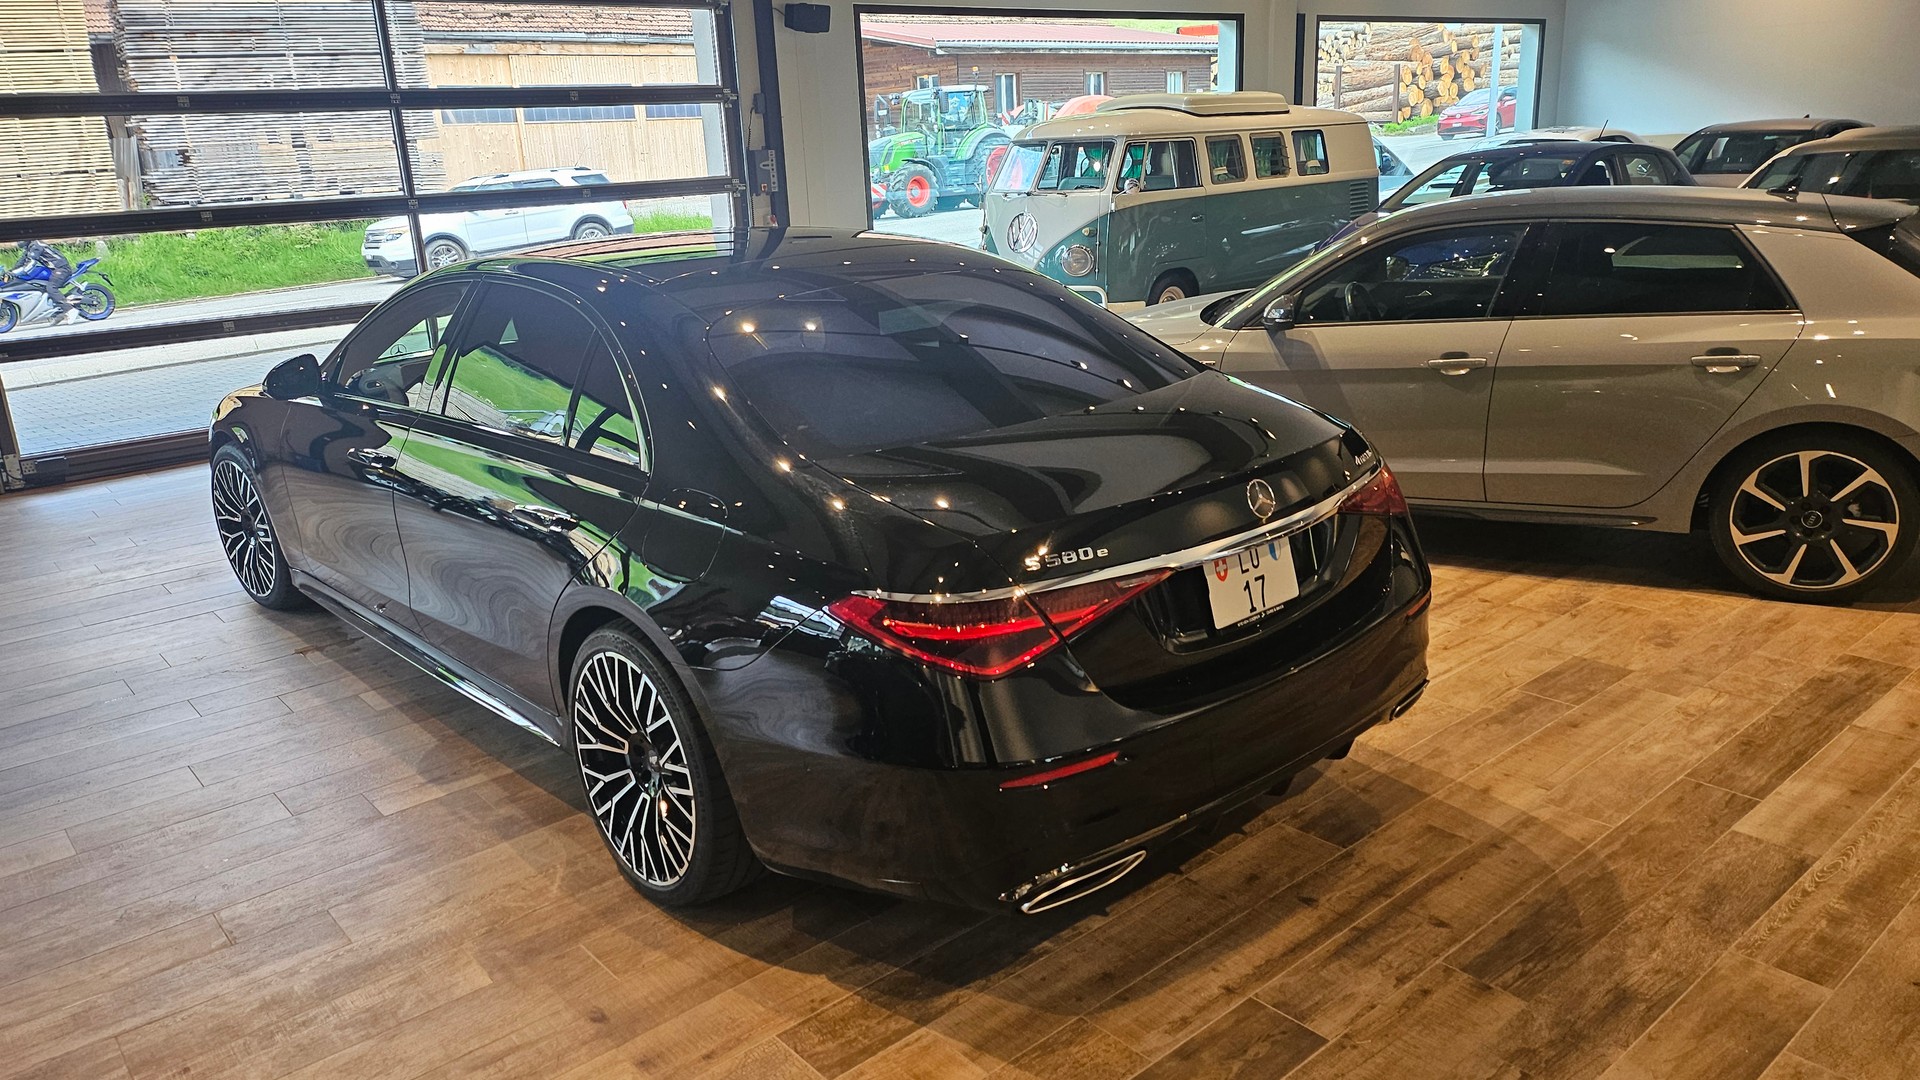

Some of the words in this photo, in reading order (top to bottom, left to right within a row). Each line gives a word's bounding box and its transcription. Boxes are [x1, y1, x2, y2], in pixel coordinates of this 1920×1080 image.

[1008, 212, 1038, 253] VW
[1024, 554, 1041, 571] S
[1238, 547, 1260, 575] LU
[1243, 574, 1266, 613] 17
